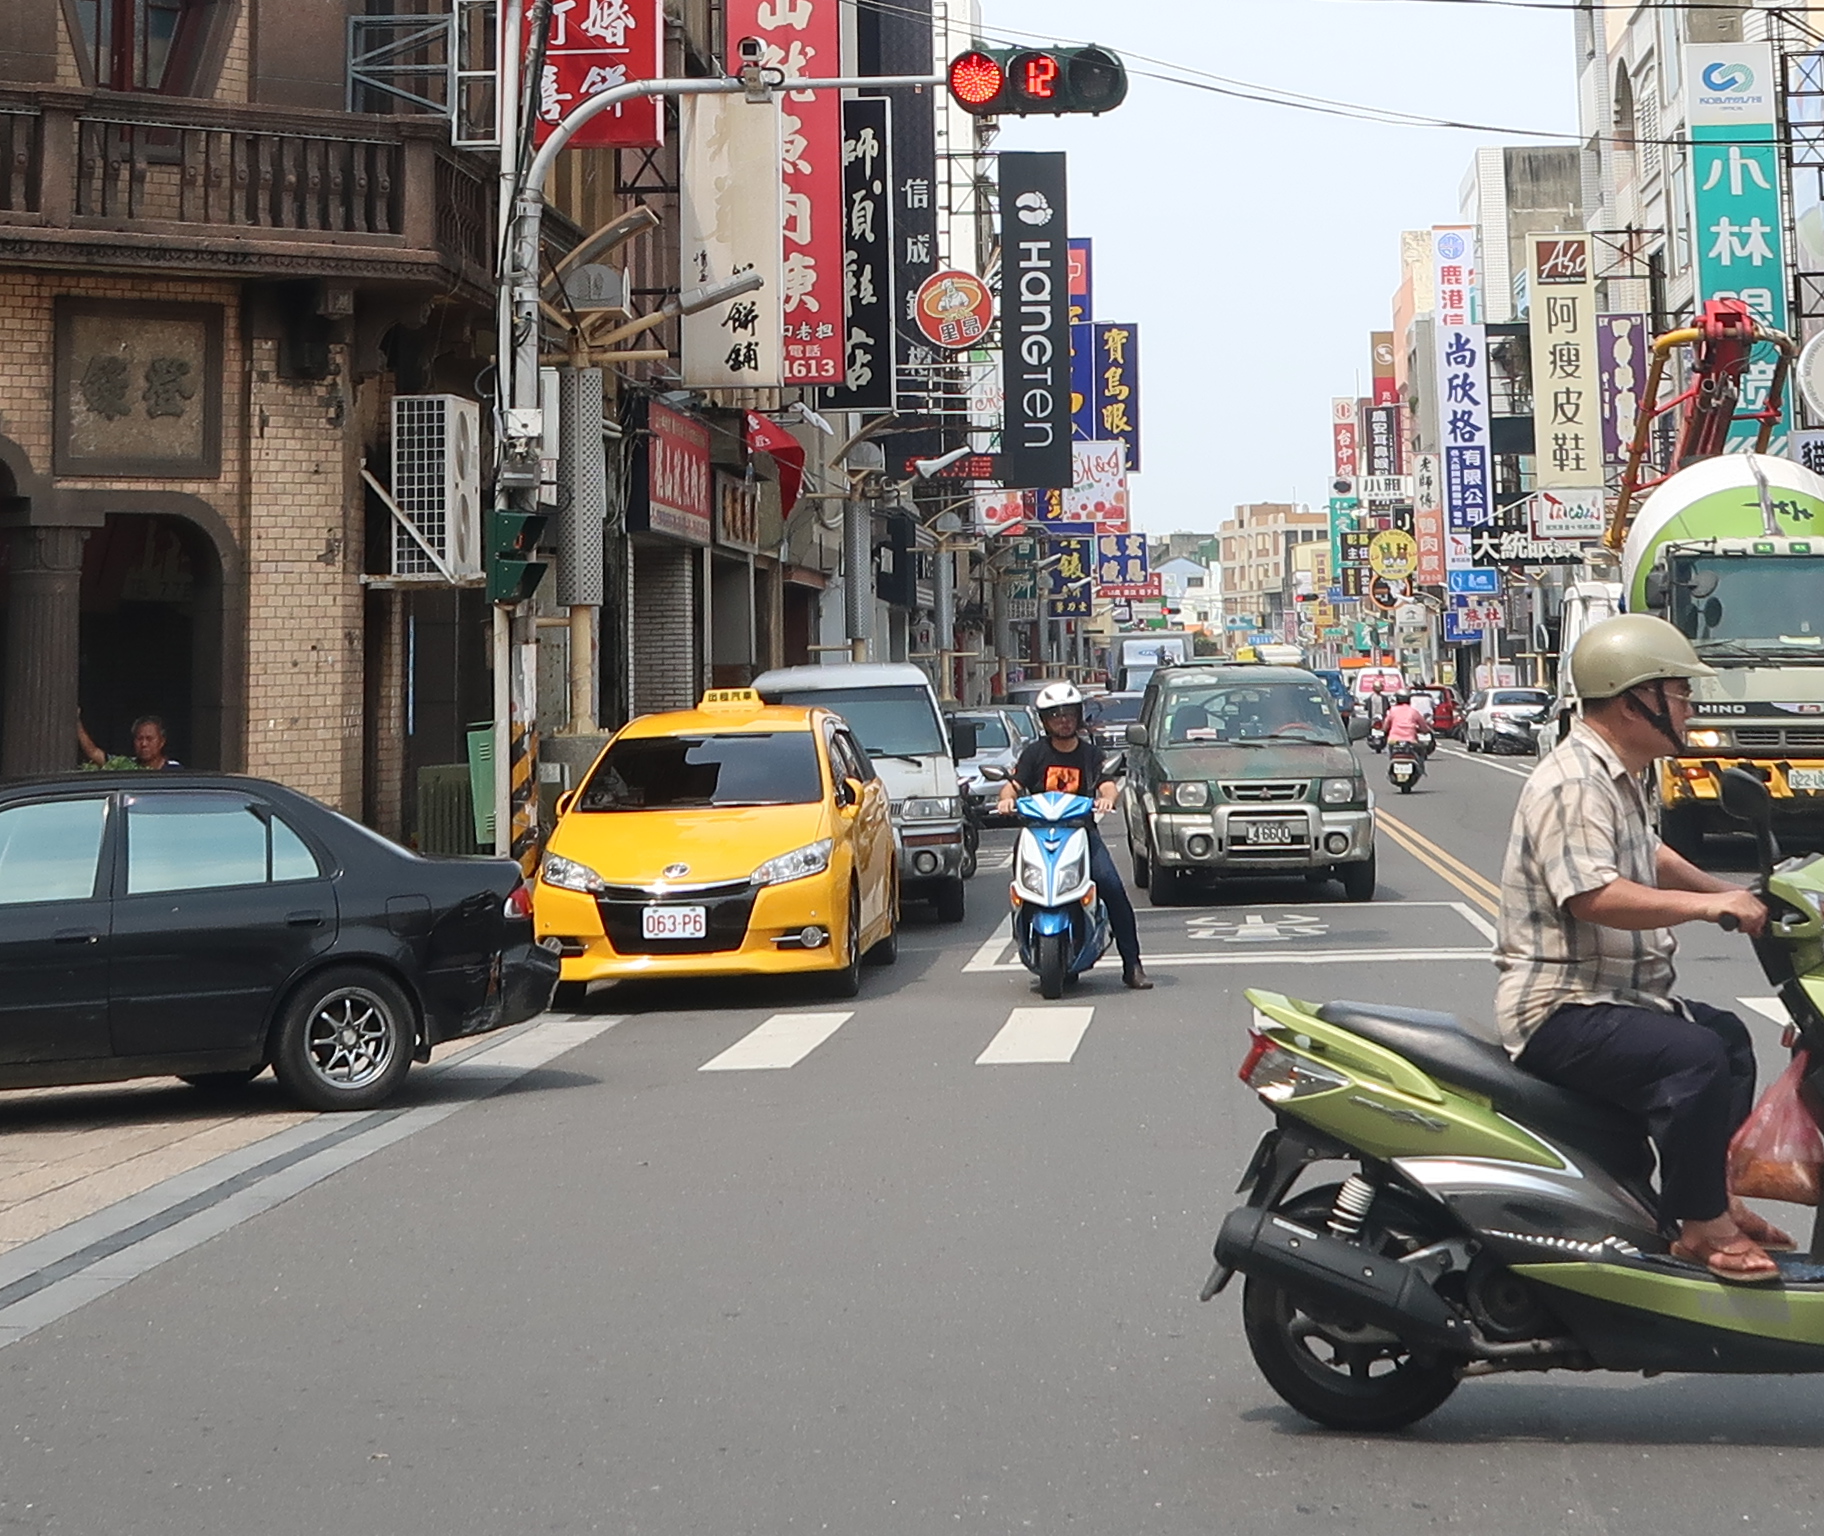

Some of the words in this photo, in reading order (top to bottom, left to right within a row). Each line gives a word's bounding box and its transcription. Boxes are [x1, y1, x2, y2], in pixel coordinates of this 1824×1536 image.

[1026, 58, 1056, 97] 12
[1445, 332, 1483, 444] 尚欣格
[1546, 296, 1587, 472] 阿瘦皮鞋
[1462, 449, 1484, 524] 有限公司
[1698, 704, 1747, 714] HINO
[645, 914, 702, 933] 063-P6
